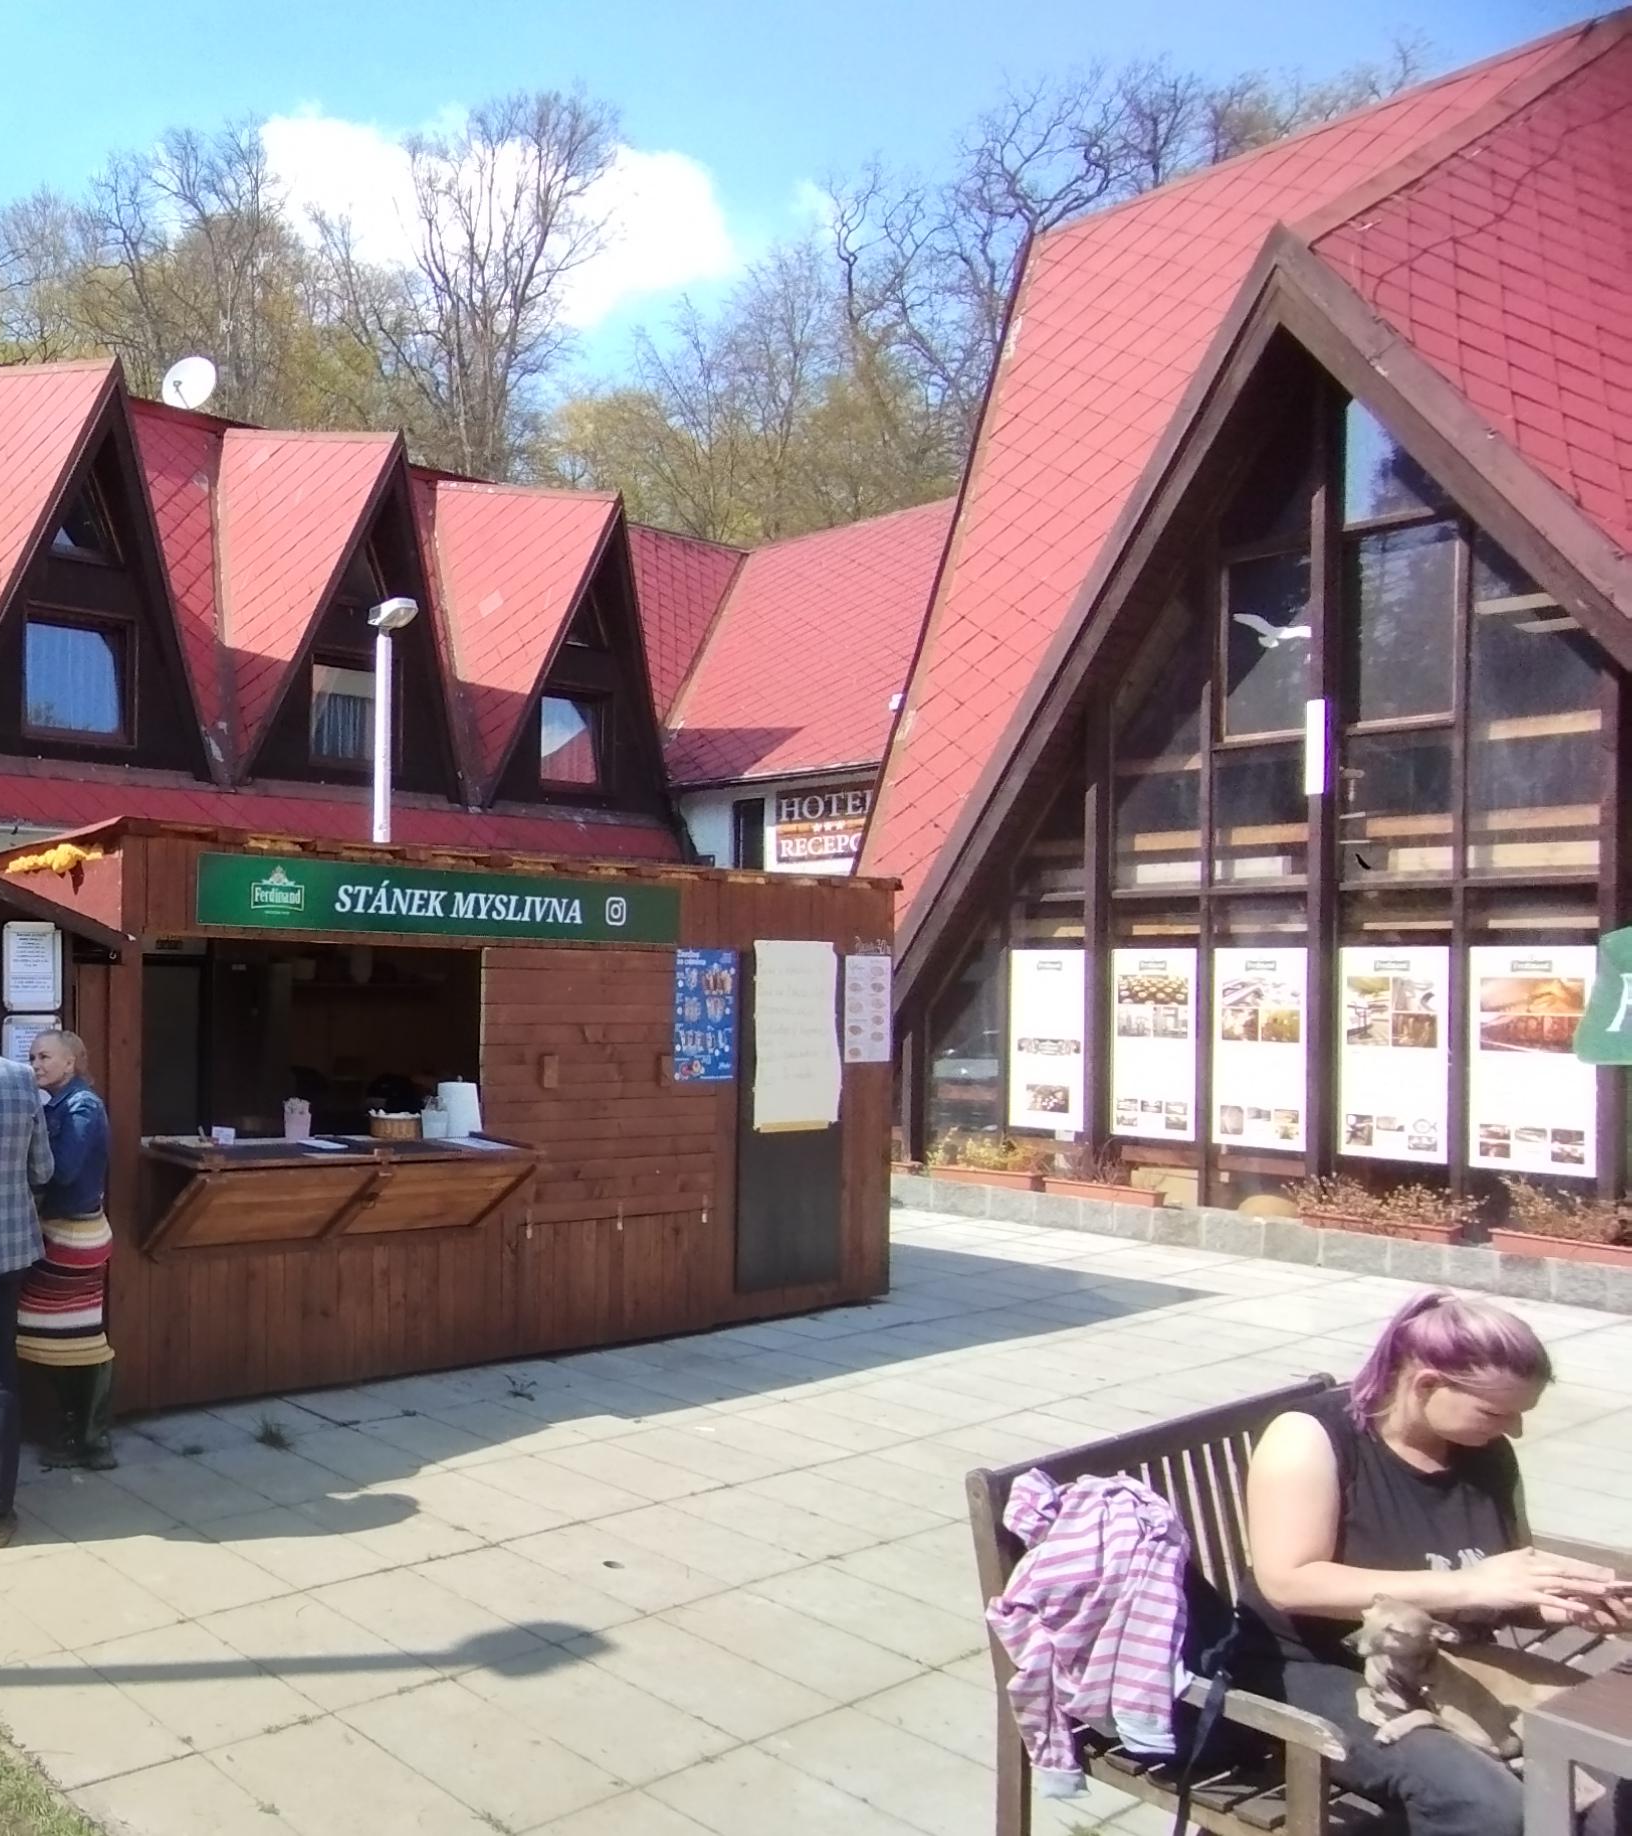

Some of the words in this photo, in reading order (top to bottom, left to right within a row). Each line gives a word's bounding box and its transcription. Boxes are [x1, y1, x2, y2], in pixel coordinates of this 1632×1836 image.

[254, 886, 301, 905] Ferdinand
[334, 880, 448, 916] STÁNEK
[452, 893, 583, 924] MYSLIVNA
